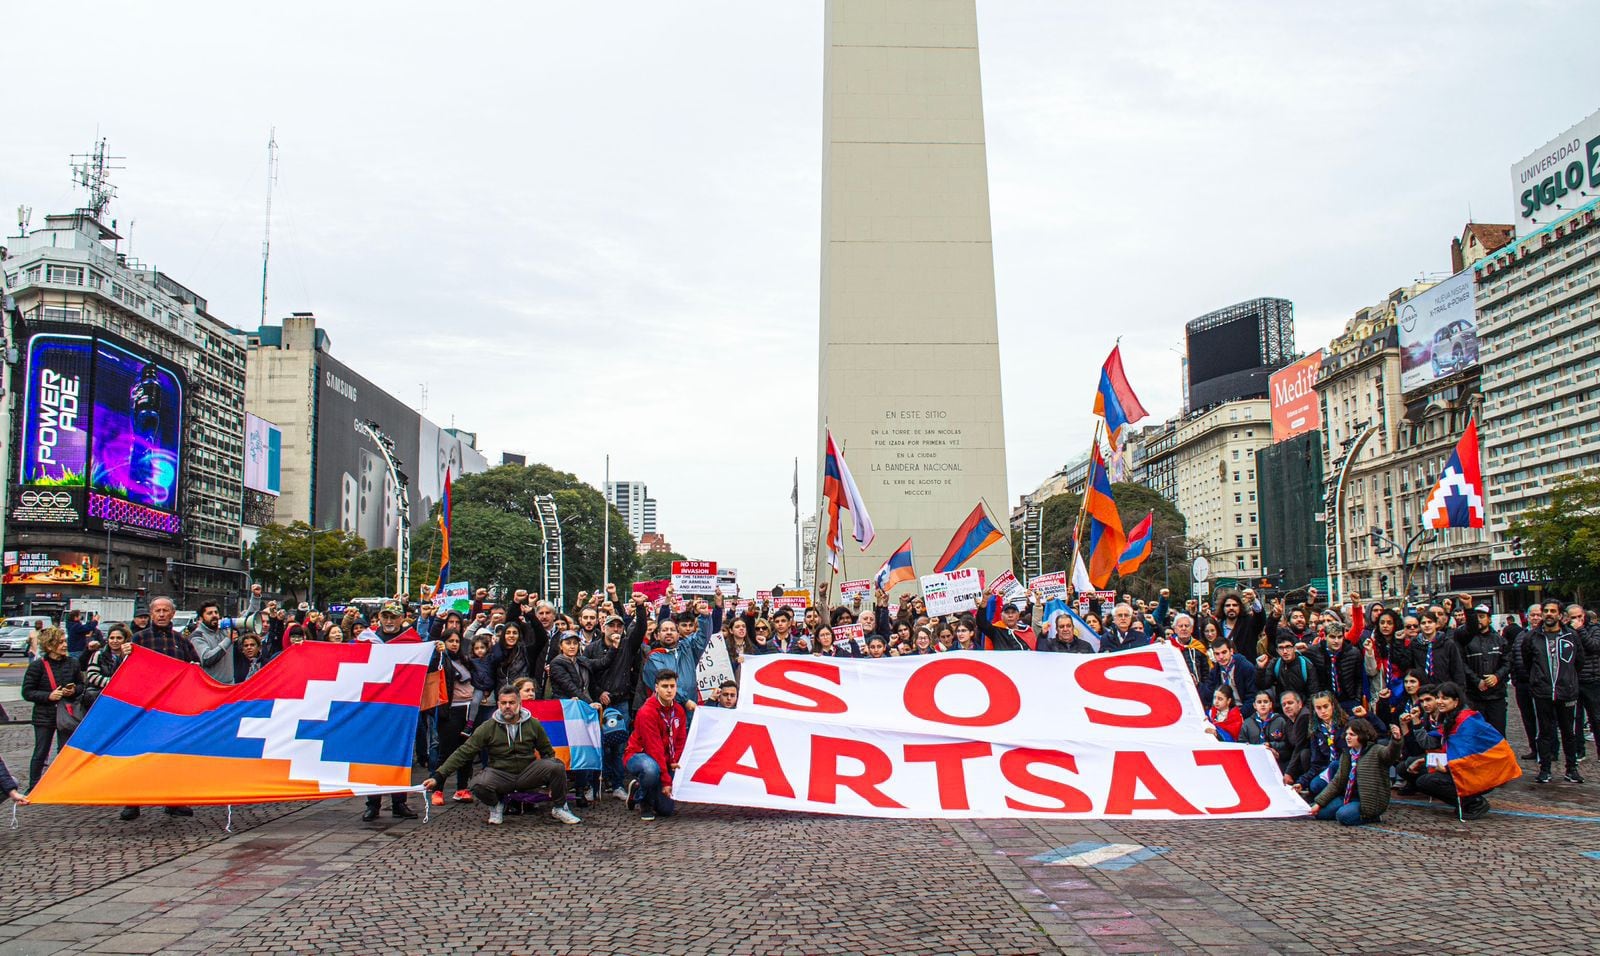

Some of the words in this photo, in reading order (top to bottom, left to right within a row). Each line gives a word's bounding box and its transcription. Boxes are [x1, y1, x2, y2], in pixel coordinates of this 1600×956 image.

[1521, 138, 1581, 184] UNIVERSIDAD
[1520, 160, 1584, 218] SIGLO
[326, 371, 358, 402] SAMSUNG
[38, 368, 61, 465] POWER
[886, 410, 896, 419] EN
[900, 410, 921, 419] ESTE
[925, 410, 947, 419] SITIO
[871, 463, 881, 472] LA
[886, 463, 920, 472] BANDERA
[924, 463, 963, 472] NACIONAL
[945, 569, 971, 581] TURCO
[926, 591, 947, 602] MATAR
[691, 721, 1271, 815] ARTSAJ
